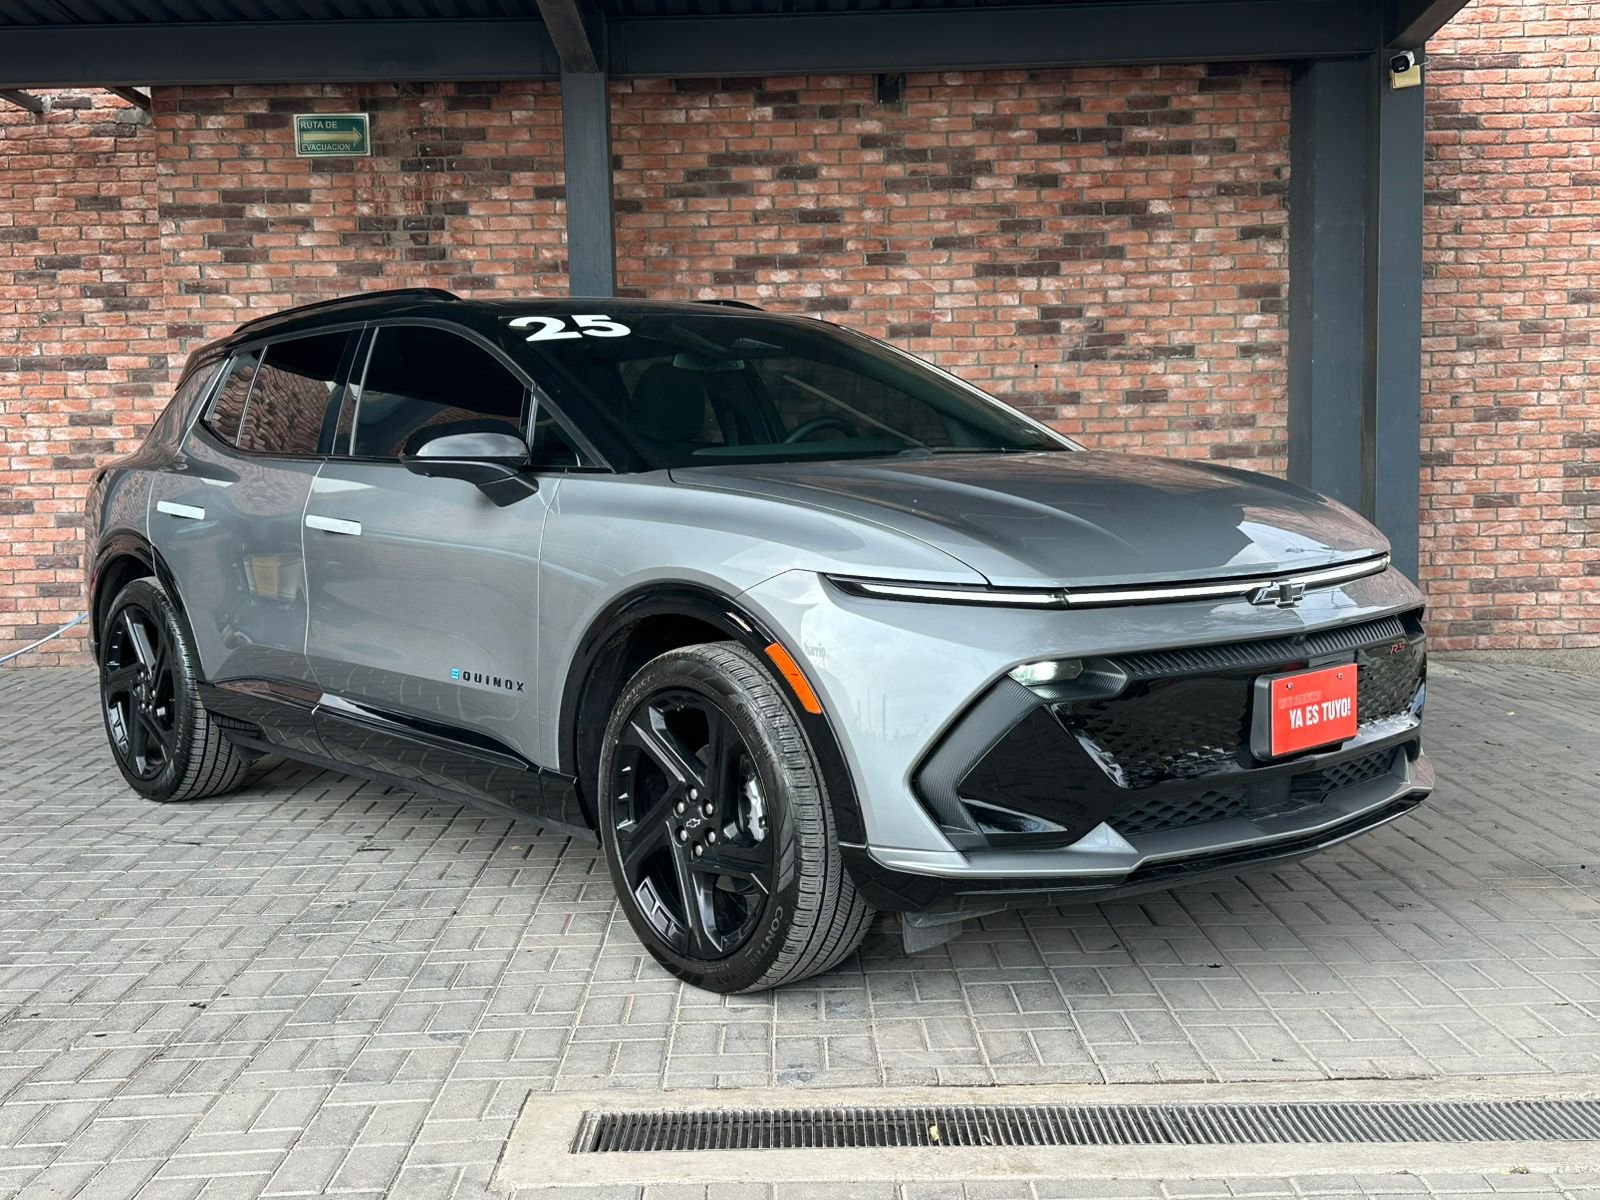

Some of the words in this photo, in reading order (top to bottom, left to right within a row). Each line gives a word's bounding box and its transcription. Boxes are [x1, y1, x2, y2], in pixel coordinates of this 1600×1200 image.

[300, 120, 323, 129] RUTA
[325, 120, 337, 129] DE
[508, 314, 631, 341] 25
[1390, 642, 1405, 655] RS
[451, 668, 525, 692] EQUINOX
[1289, 708, 1303, 729] YA
[1305, 704, 1319, 726] ES
[1321, 697, 1351, 722] TUYO!
